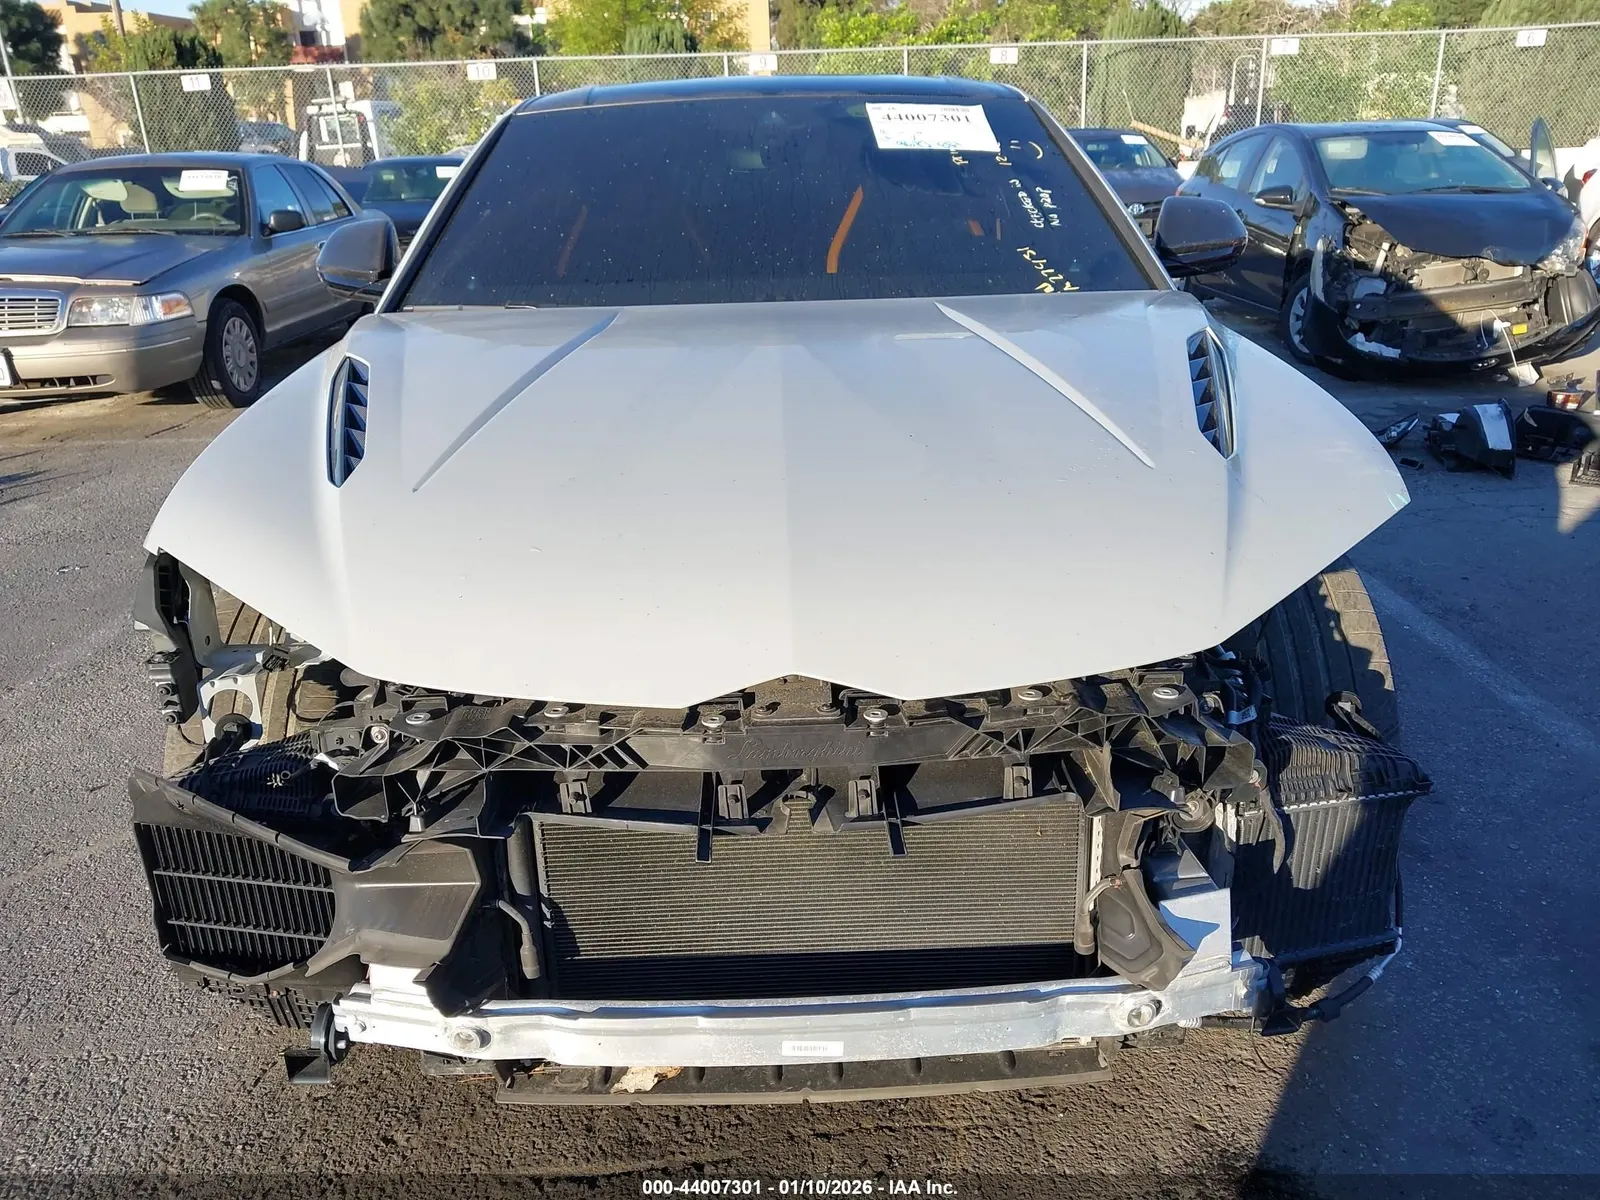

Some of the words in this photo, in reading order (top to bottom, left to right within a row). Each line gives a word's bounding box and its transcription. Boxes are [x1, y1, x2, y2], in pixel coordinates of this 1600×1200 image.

[1527, 31, 1535, 44] 6
[1000, 49, 1008, 61] 8
[759, 56, 767, 69] 9
[475, 65, 490, 78] 10
[190, 76, 201, 89] 11
[881, 112, 973, 124] 44007301
[727, 740, 865, 762] Lamborghini
